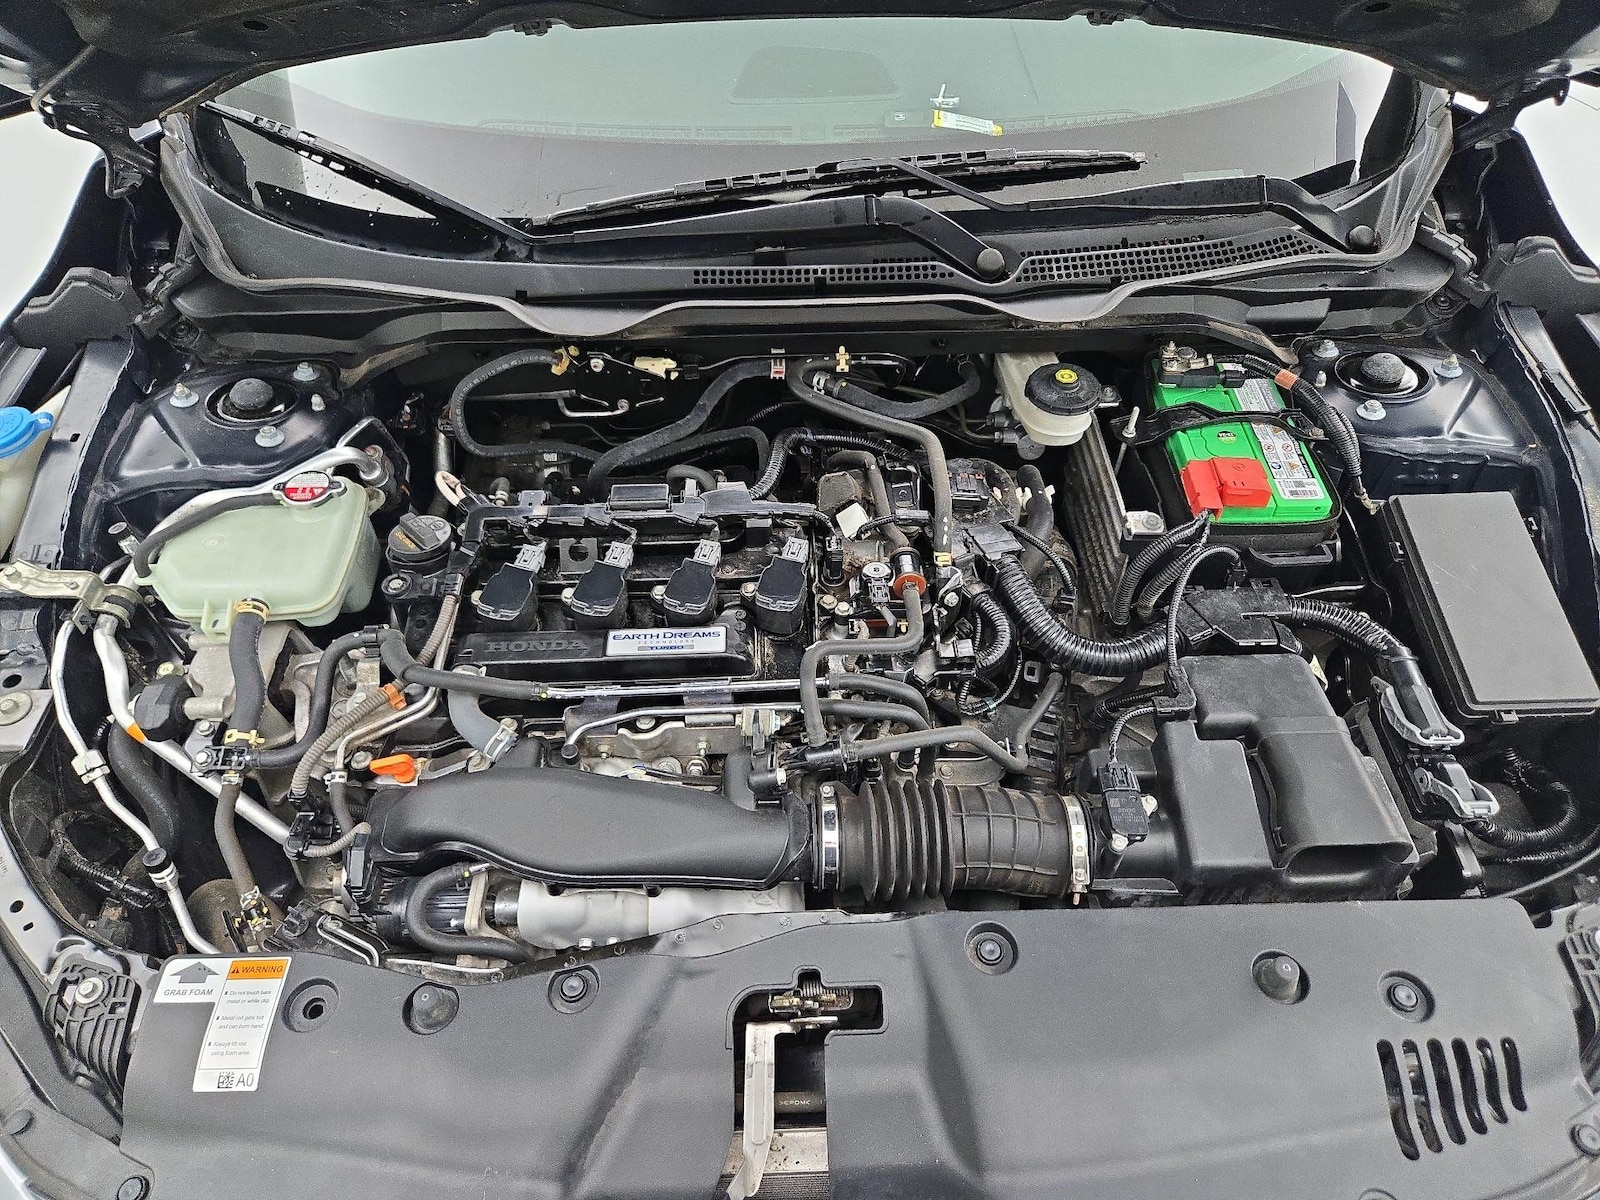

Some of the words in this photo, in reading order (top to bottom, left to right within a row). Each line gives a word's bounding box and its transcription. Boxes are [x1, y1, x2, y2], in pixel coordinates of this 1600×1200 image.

[662, 631, 721, 639] DREAMS
[484, 640, 590, 652] HONDA
[241, 965, 284, 974] WARNING
[189, 988, 214, 996] FOAM
